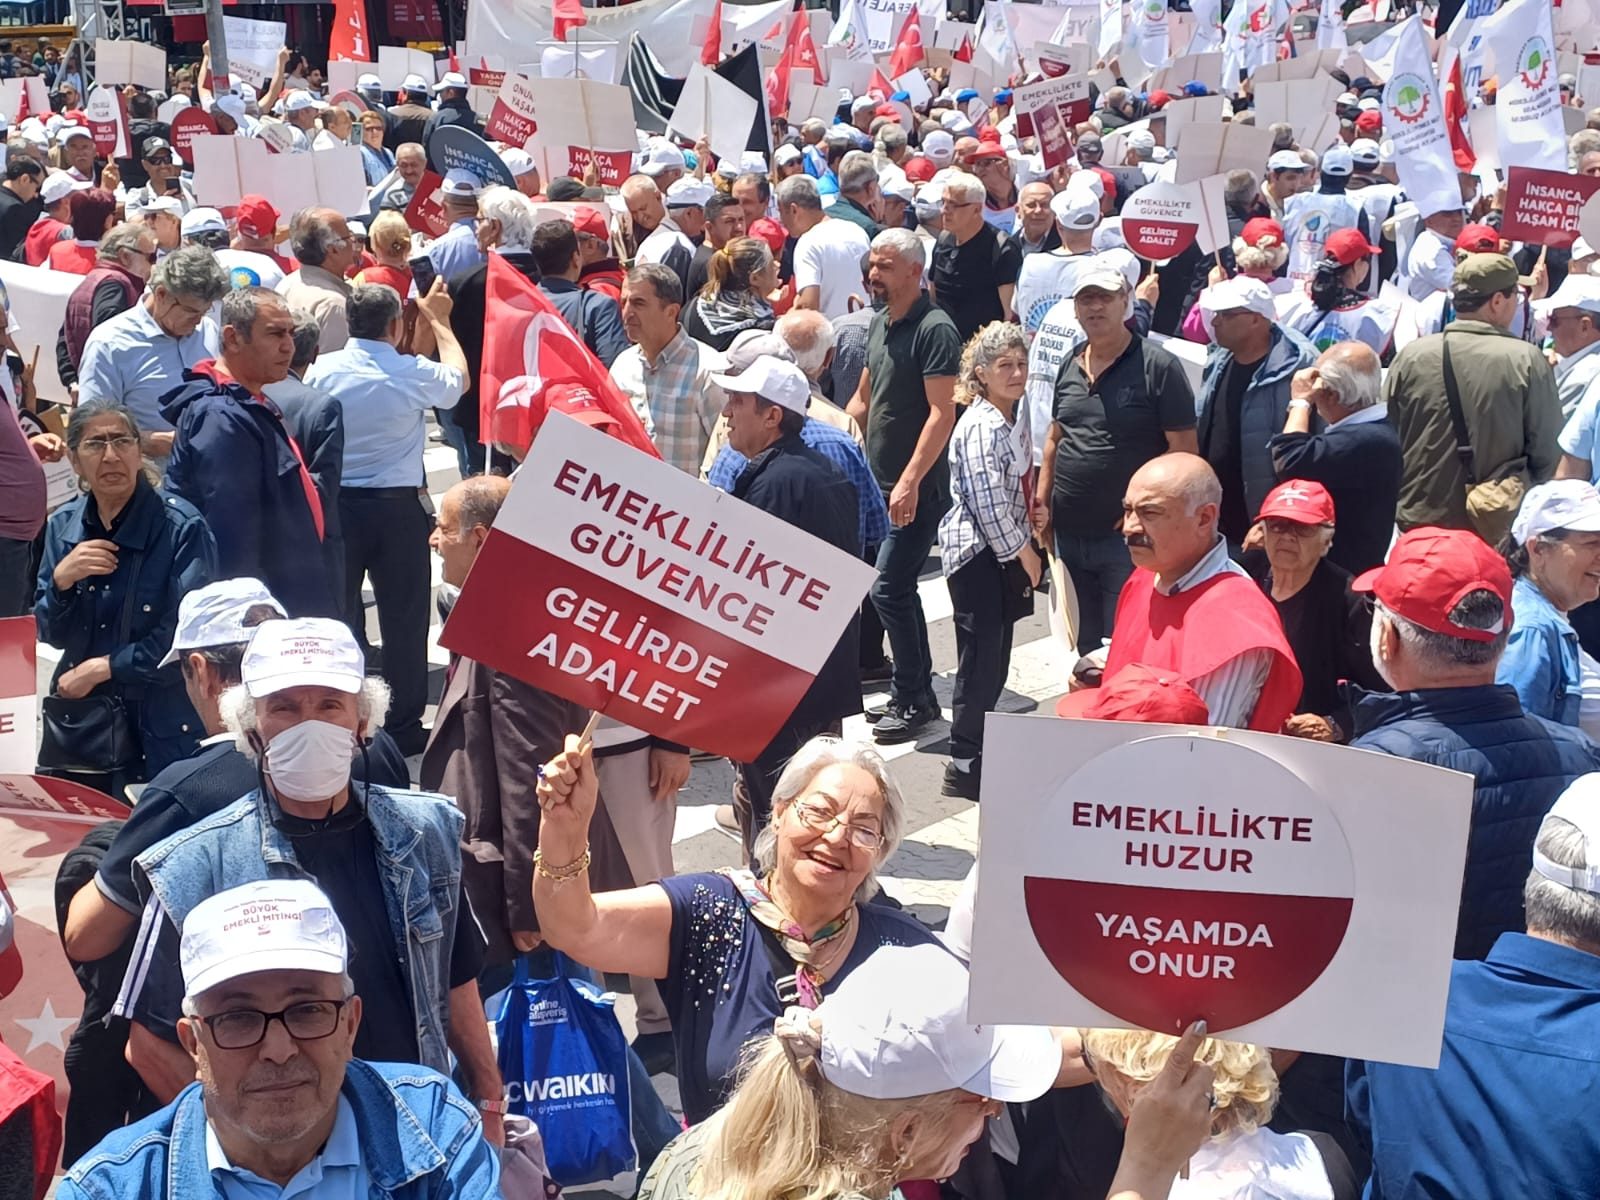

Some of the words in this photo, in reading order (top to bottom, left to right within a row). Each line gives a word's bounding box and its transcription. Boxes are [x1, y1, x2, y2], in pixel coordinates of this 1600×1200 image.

[1022, 81, 1083, 101] EMEKLİLİKTE
[494, 121, 526, 143] PAYLAŞI
[503, 112, 532, 133] HAKÇA
[568, 162, 618, 179] PAYŞIM
[1134, 198, 1191, 209] EMEKLİLİKTE
[1525, 182, 1585, 205] İNSANCA,
[1140, 207, 1183, 217] GÜVENCE
[1519, 198, 1562, 214] HAKÇA
[1566, 203, 1580, 217] Bİ
[1139, 226, 1178, 237] GELİRDE
[1515, 211, 1558, 228] YAŞAM
[1560, 215, 1580, 232] İÇİ
[1139, 235, 1176, 246] ADALET
[553, 459, 831, 612] EMEKLİLİKTE
[570, 522, 776, 636] GÜVENCE
[545, 586, 729, 689] GELİRDE
[526, 632, 701, 722] ADALET
[1072, 801, 1313, 842] EMEKLİLİKTE
[1125, 841, 1254, 874] HUZUR
[242, 904, 279, 916] BÜYÜK
[223, 914, 260, 931] EMEKLİ
[262, 911, 302, 922] MİTİNGİ
[1095, 912, 1274, 949] YAŞAMDA
[1128, 949, 1236, 980] ONUR
